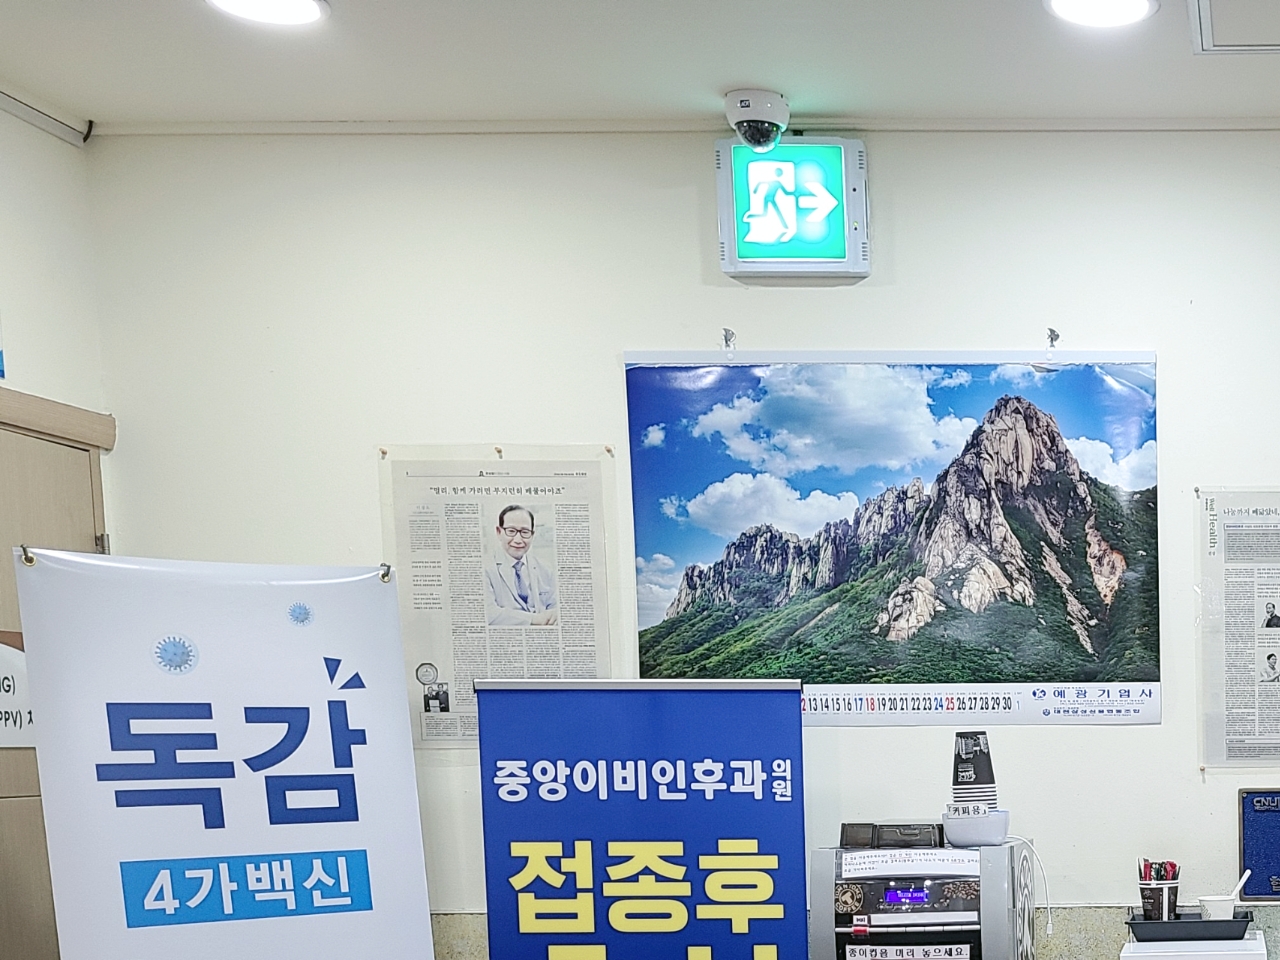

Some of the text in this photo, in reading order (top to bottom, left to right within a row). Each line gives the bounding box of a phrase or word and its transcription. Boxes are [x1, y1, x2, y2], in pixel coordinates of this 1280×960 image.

[1209, 513, 1218, 548] Health
[0, 674, 16, 696] G)
[1053, 688, 1153, 699] 예광기업사
[808, 697, 818, 711] 13
[819, 697, 830, 711] 14
[831, 697, 840, 711] 15
[842, 697, 852, 711] 16
[854, 697, 864, 711] 17
[865, 697, 876, 711] 18
[876, 697, 887, 711] 19
[888, 697, 898, 711] 20
[900, 697, 909, 711] 21
[911, 697, 922, 711] 22
[922, 697, 932, 711] 23
[934, 697, 944, 711] 24
[945, 697, 955, 711] 25
[956, 697, 966, 711] 26
[968, 697, 978, 711] 27
[980, 697, 990, 710] 28
[991, 697, 1000, 710] 29
[1002, 697, 1012, 710] 30
[95, 700, 367, 829] 독감
[144, 856, 352, 916] 4가백신
[508, 838, 785, 934] 접종후
[895, 948, 915, 958] 미리
